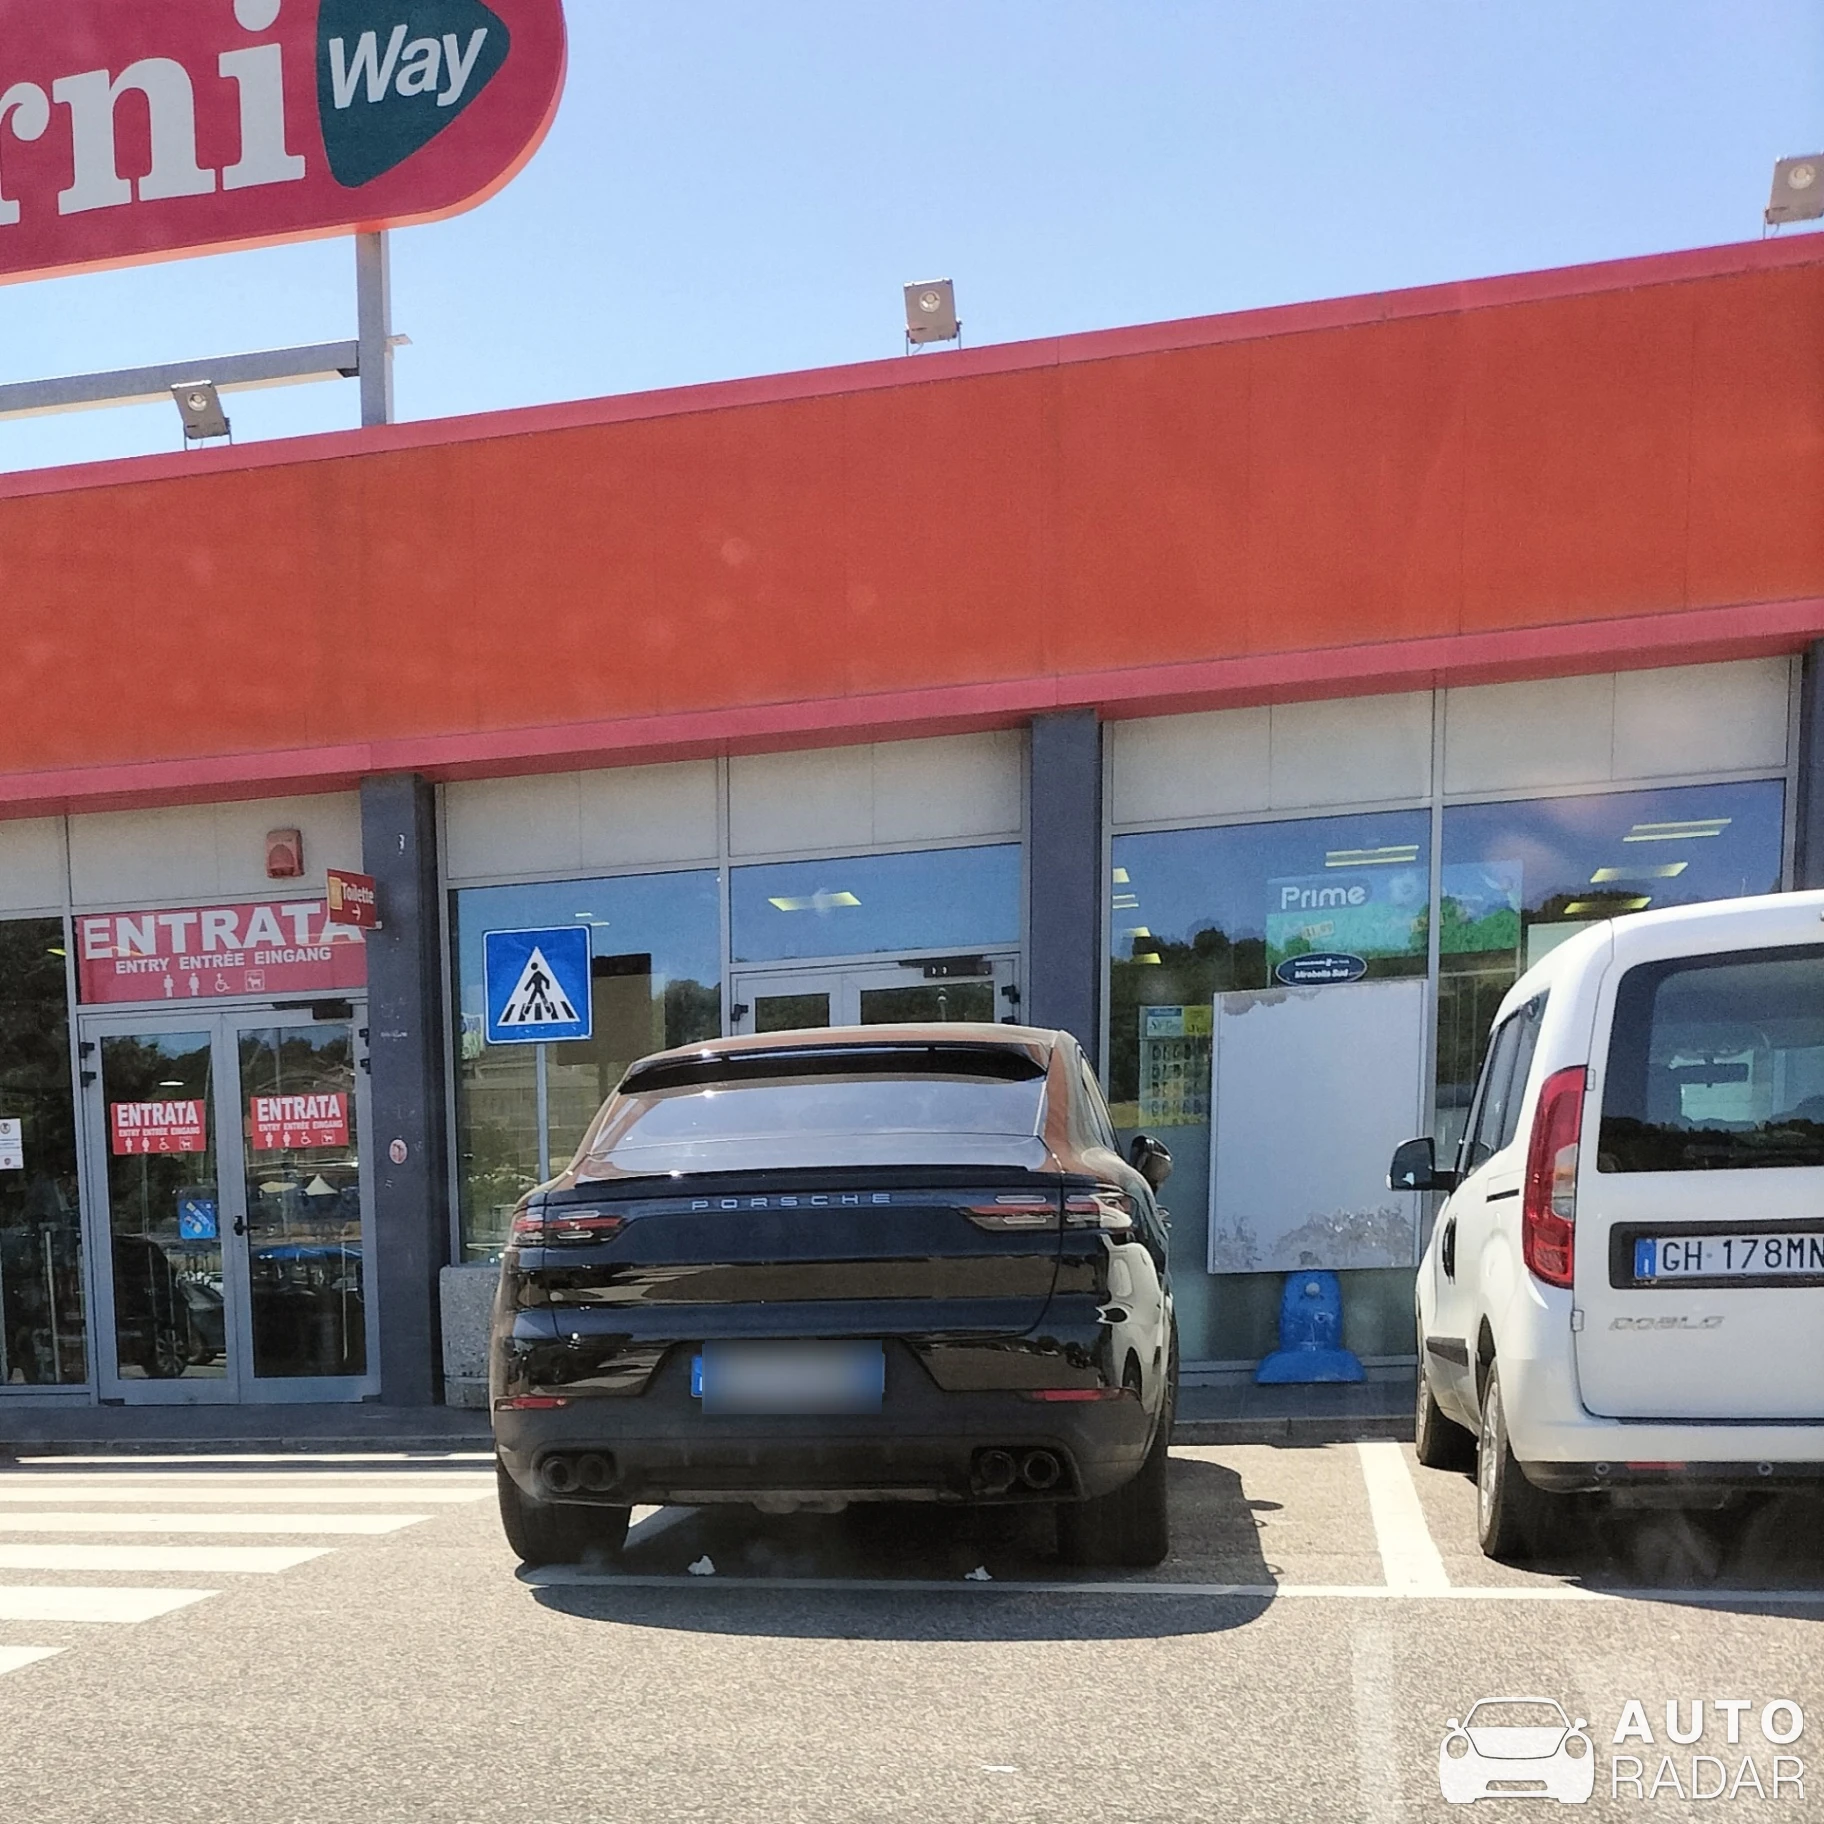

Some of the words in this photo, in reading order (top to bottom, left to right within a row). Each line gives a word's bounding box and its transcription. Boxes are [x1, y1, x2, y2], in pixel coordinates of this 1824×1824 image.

[328, 24, 488, 109] Way
[341, 882, 374, 904] Toilette
[1281, 886, 1366, 910] Prime
[83, 902, 366, 960] ENTRATA
[115, 957, 170, 974] ENTRY
[179, 950, 245, 970] ENTRÉE
[254, 947, 332, 965] EINGANG
[117, 1101, 199, 1127] ENTRATA
[257, 1095, 341, 1122] ENTRATA
[691, 1193, 891, 1211] PORSCHE
[1662, 1241, 1702, 1271] GH
[1723, 1237, 1824, 1270] 178MN
